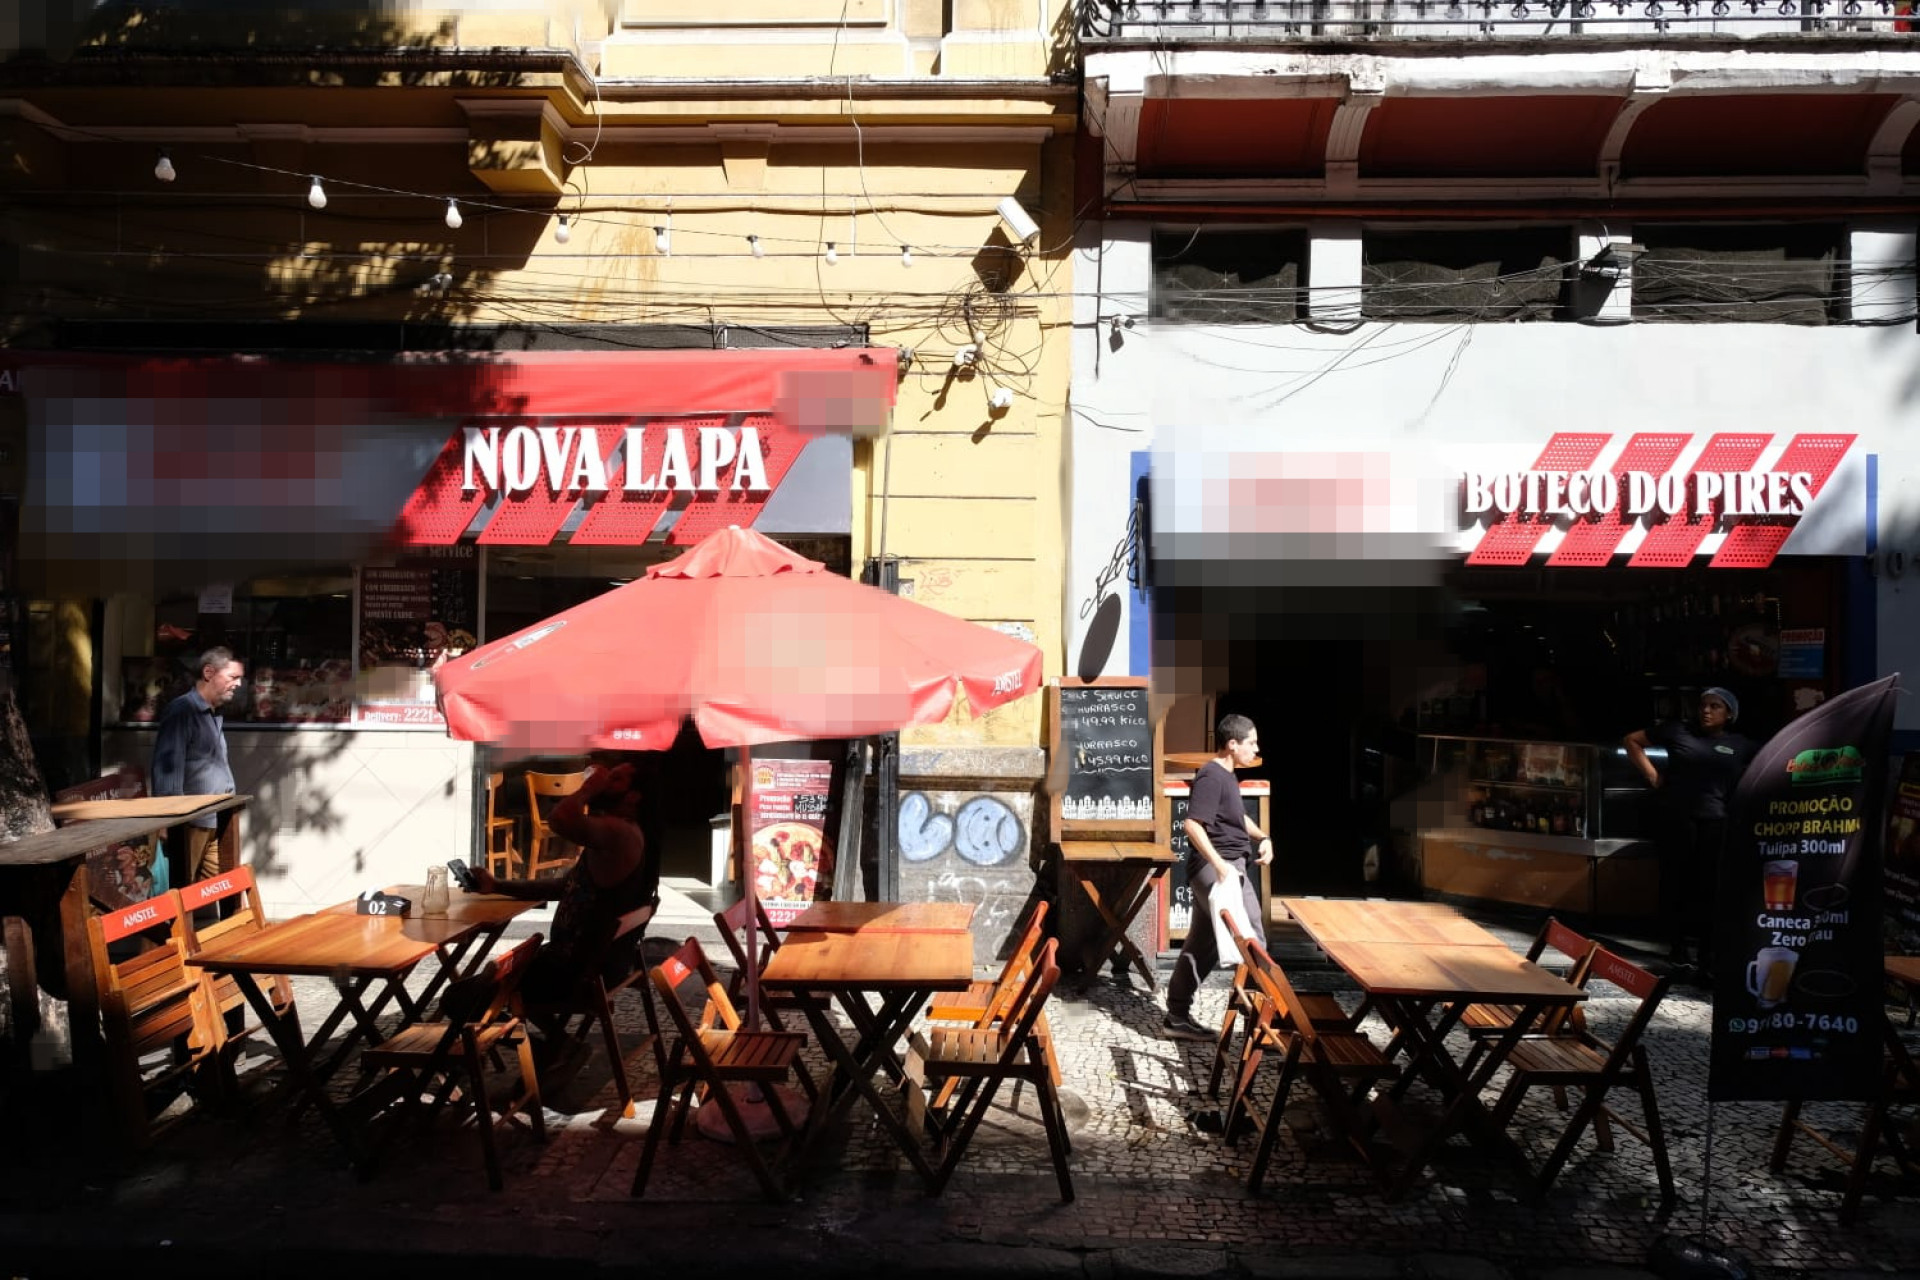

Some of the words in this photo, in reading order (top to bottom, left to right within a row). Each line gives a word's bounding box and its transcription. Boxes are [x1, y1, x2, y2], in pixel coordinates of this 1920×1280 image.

[461, 426, 608, 496] NOVA
[624, 426, 771, 490] LAPA
[1627, 470, 1688, 514] DO
[1695, 470, 1812, 516] PIRES
[1769, 795, 1853, 815] PROMOÇÃO
[1754, 821, 1800, 837] CHOPP
[1801, 817, 1861, 835] BRAHM
[1757, 841, 1798, 859] Tulipa
[1800, 839, 1846, 855] 300ml
[200, 878, 233, 898] AMSTEL
[123, 905, 159, 928] AMSTEL
[368, 900, 386, 915] 02
[1756, 913, 1811, 930] Caneca
[1771, 931, 1807, 947] Zero
[1607, 963, 1637, 985] AMSTEL
[1746, 1012, 1859, 1034] 980-7640
